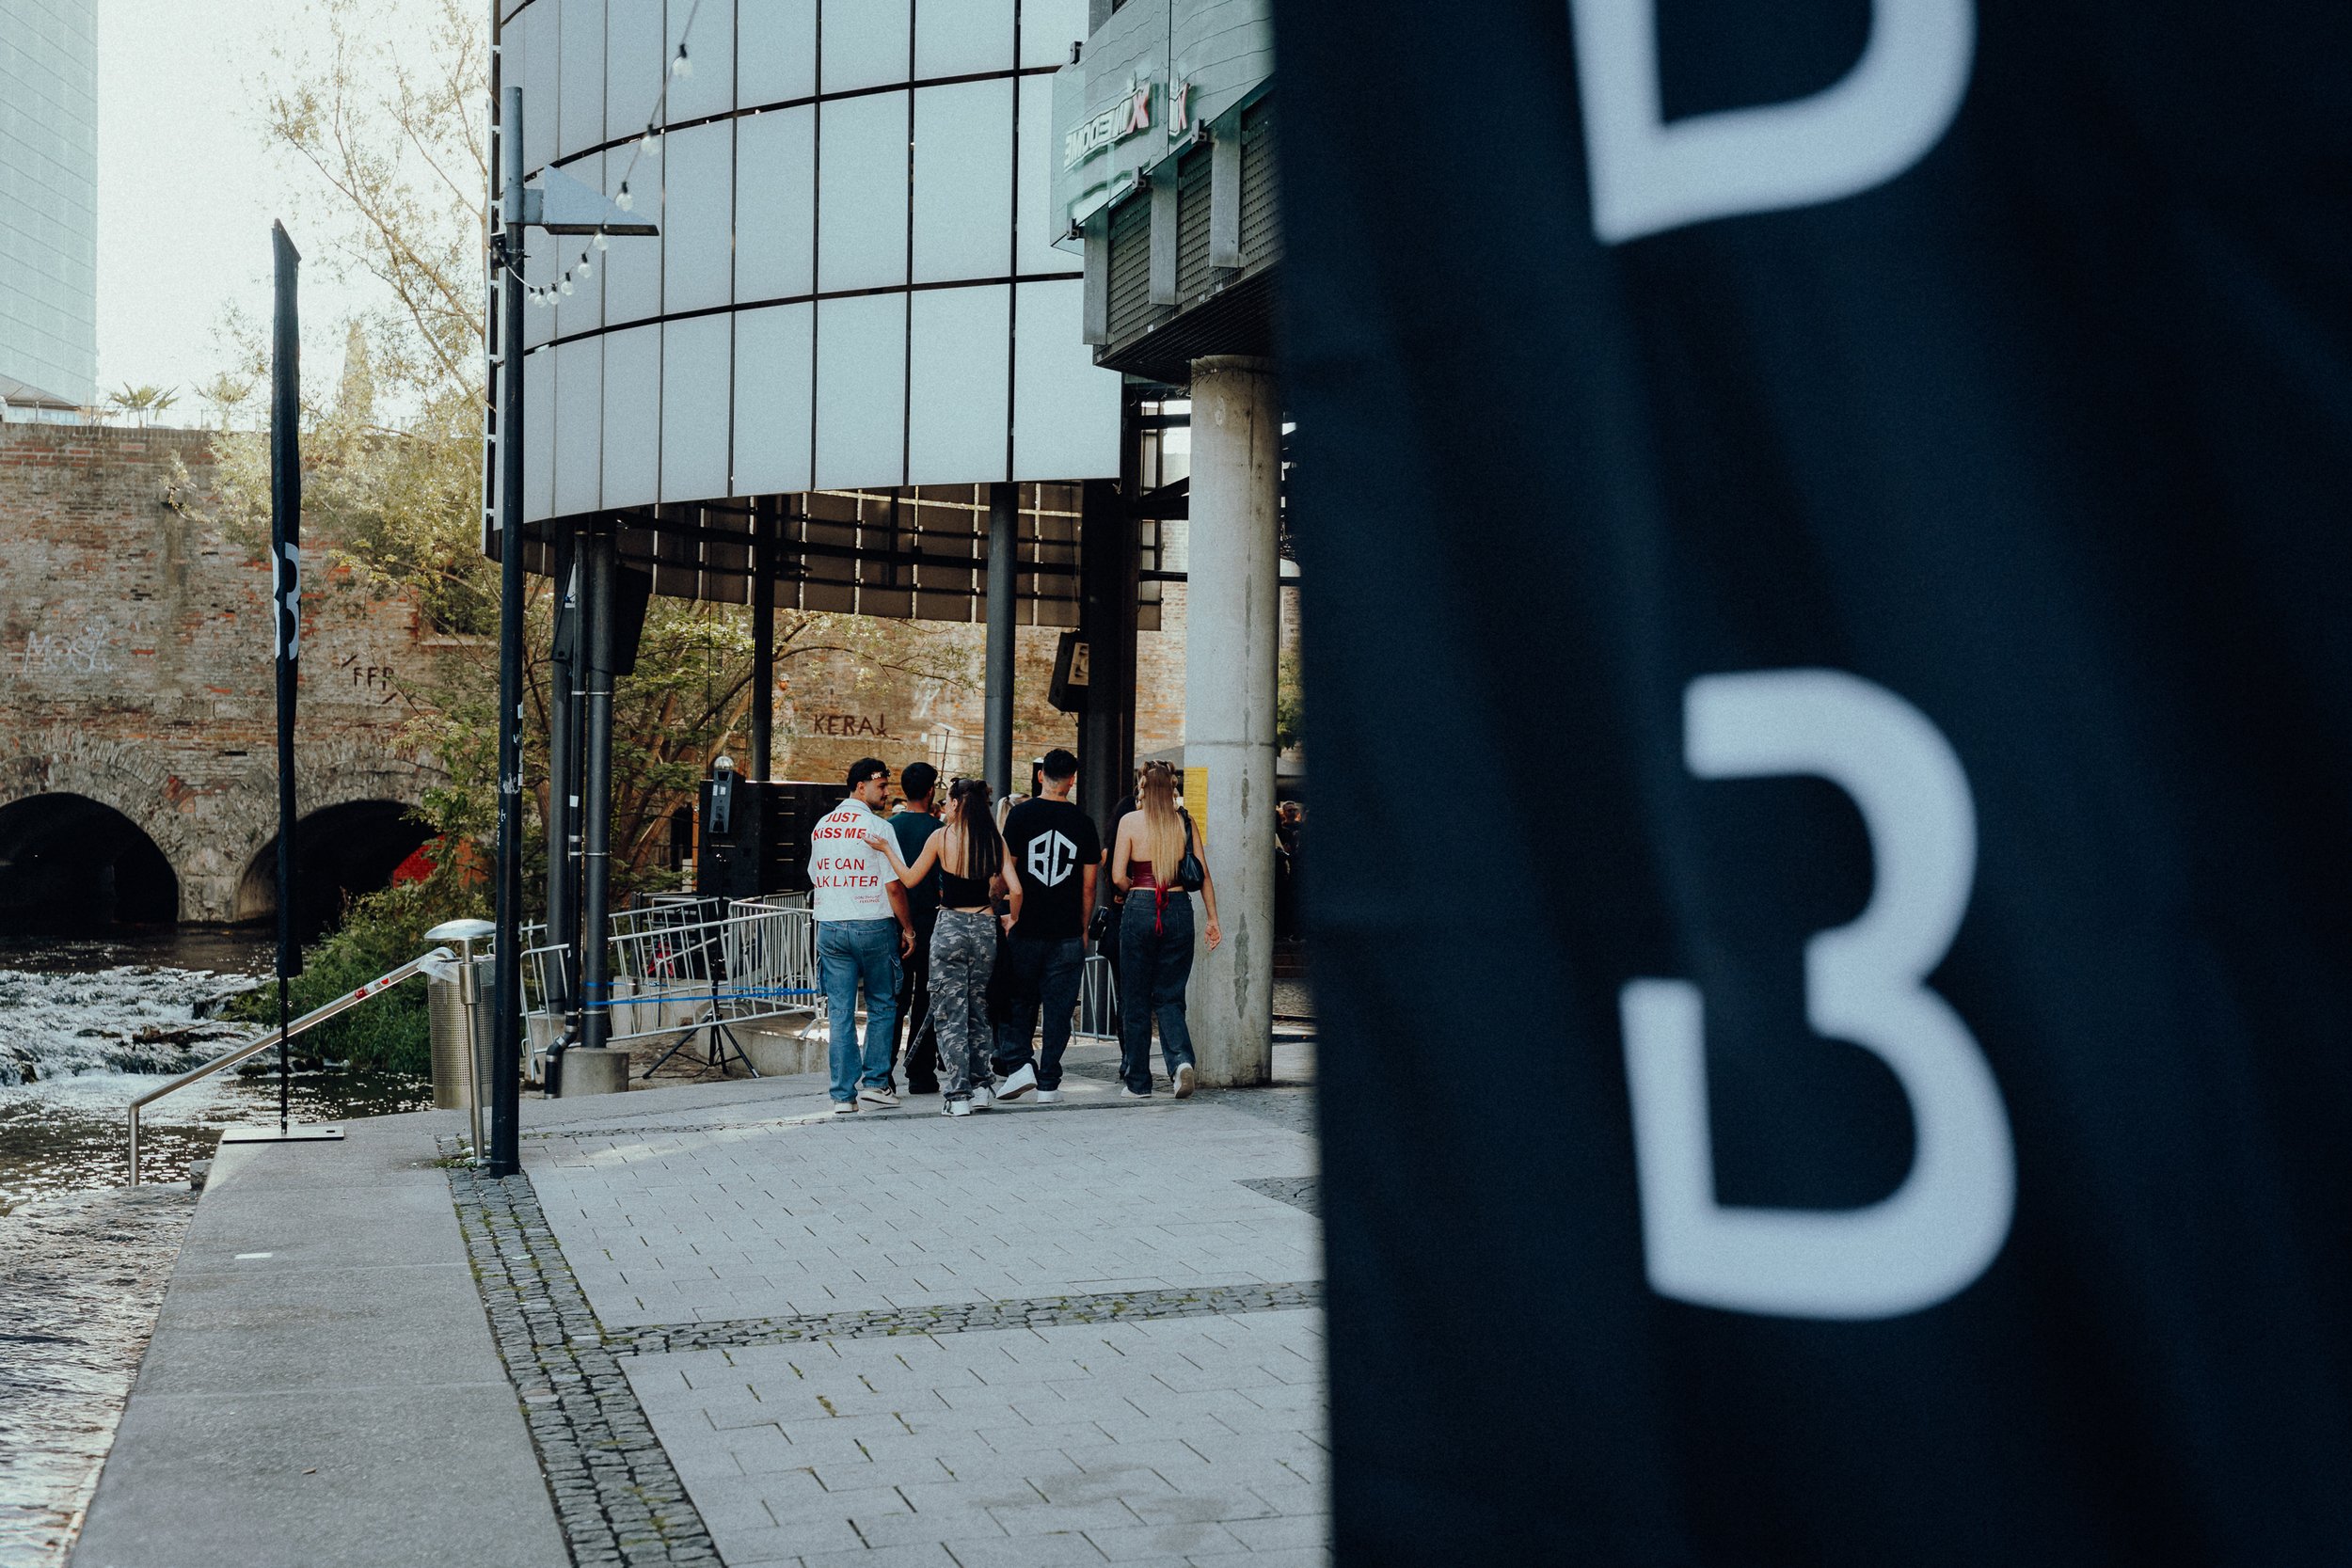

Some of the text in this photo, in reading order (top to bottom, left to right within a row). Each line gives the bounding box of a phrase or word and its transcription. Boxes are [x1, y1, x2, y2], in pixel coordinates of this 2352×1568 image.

[825, 812, 862, 823] JUST
[844, 828, 866, 839] ME
[834, 858, 865, 870] CAN
[834, 876, 879, 887] LATER
